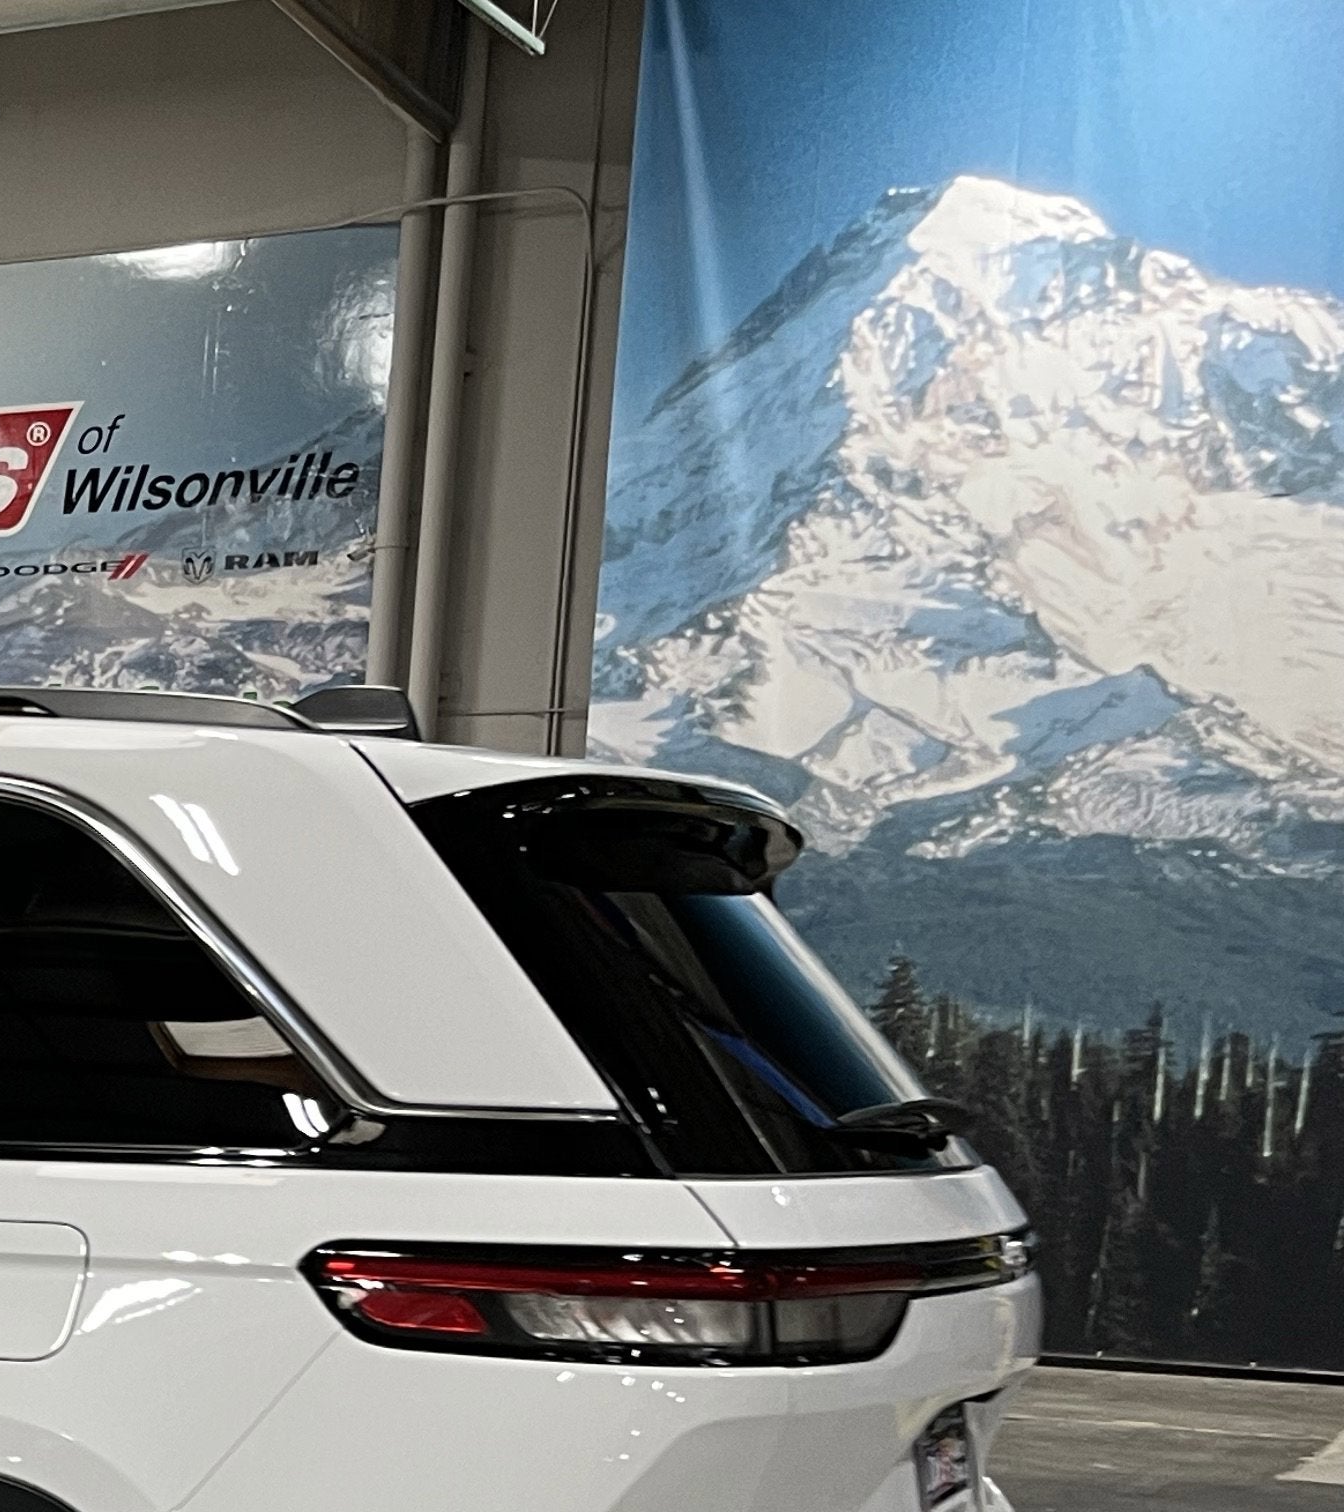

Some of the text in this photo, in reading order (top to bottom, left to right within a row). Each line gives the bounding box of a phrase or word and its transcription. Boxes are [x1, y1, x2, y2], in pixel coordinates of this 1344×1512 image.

[77, 414, 126, 455] of
[62, 450, 360, 515] Wilsonville
[224, 550, 319, 570] RAM
